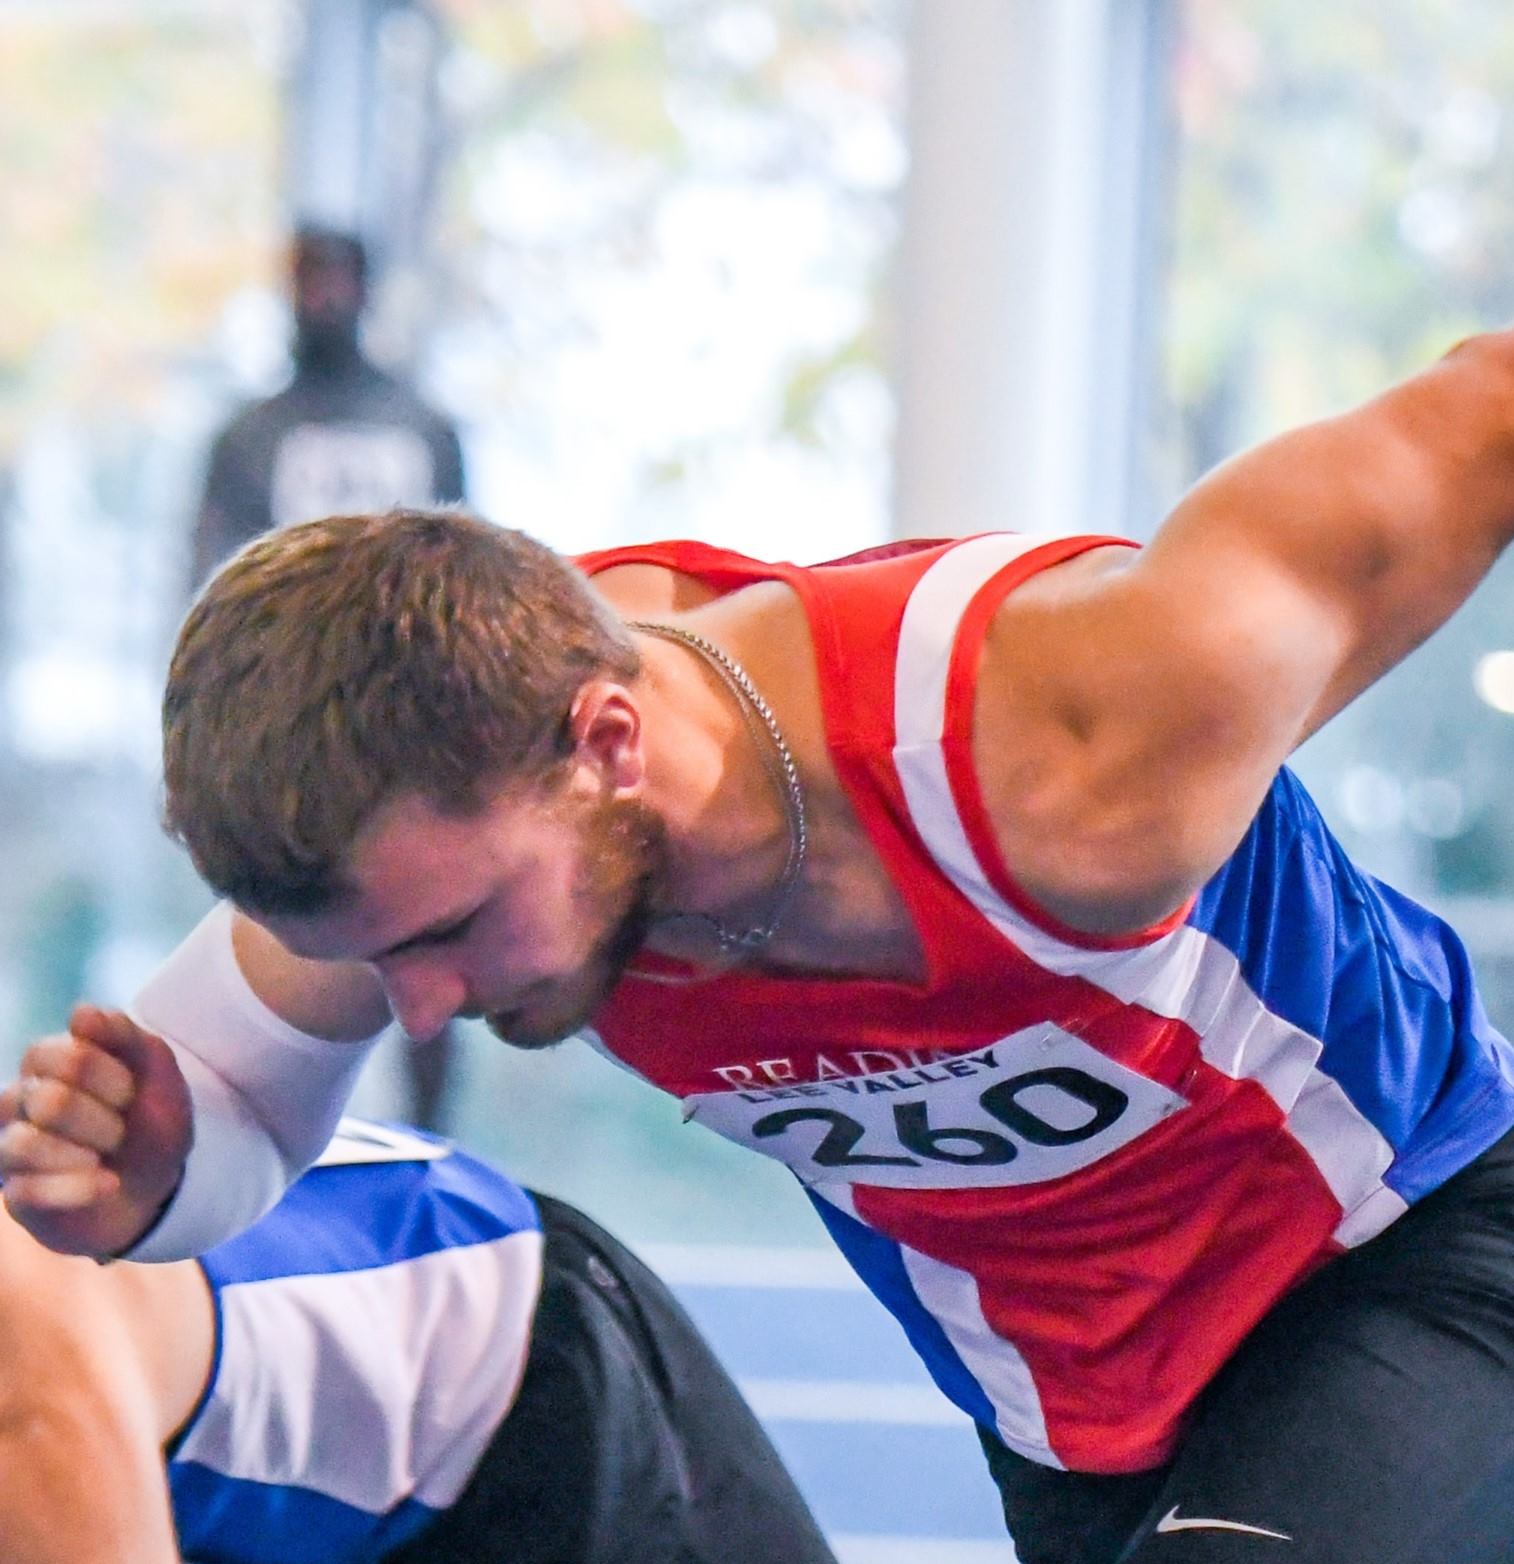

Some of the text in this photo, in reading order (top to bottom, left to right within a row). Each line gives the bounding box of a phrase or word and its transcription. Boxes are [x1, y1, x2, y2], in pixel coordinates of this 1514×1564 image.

[736, 1049, 1000, 1104] LEE VALLEY
[752, 1066, 1129, 1168] 260
